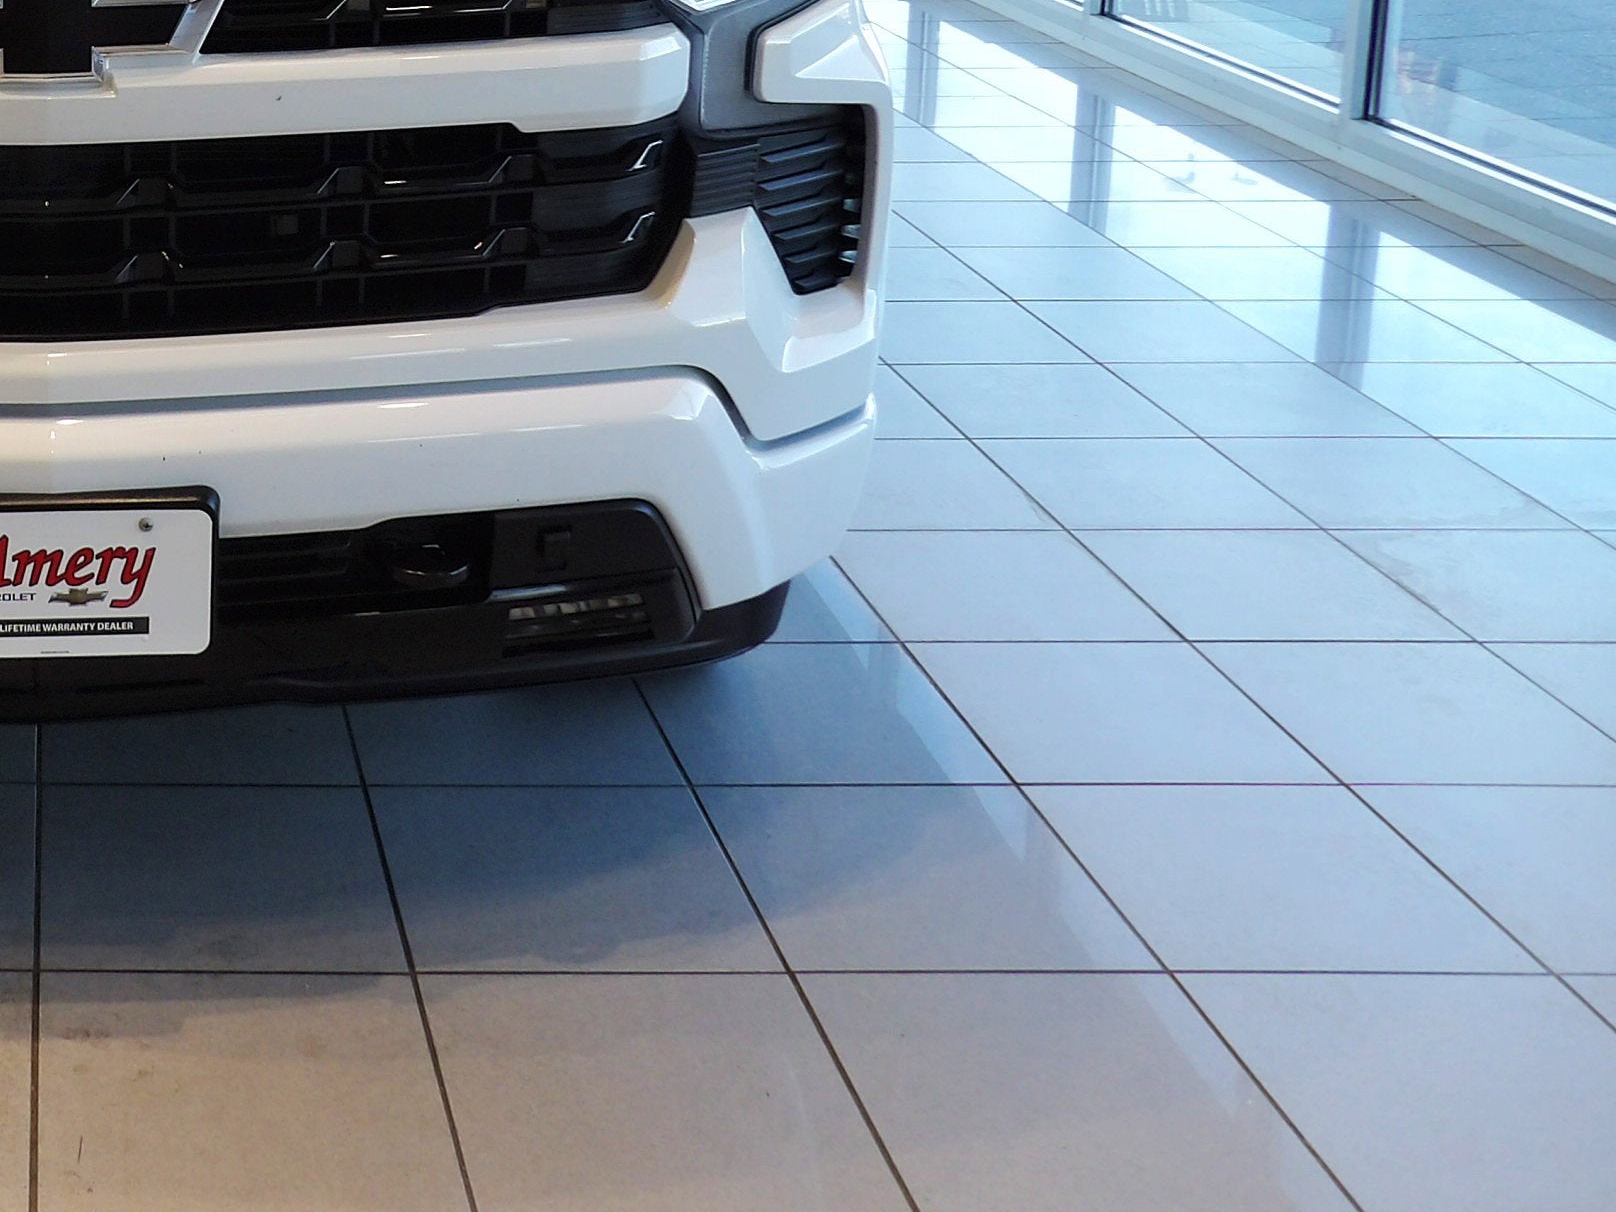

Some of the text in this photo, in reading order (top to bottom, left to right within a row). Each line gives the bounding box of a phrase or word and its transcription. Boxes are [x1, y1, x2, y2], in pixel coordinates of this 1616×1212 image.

[0, 623, 41, 633] LIFETIME
[42, 622, 96, 632] WARRANTY
[97, 621, 134, 631] DEALER
